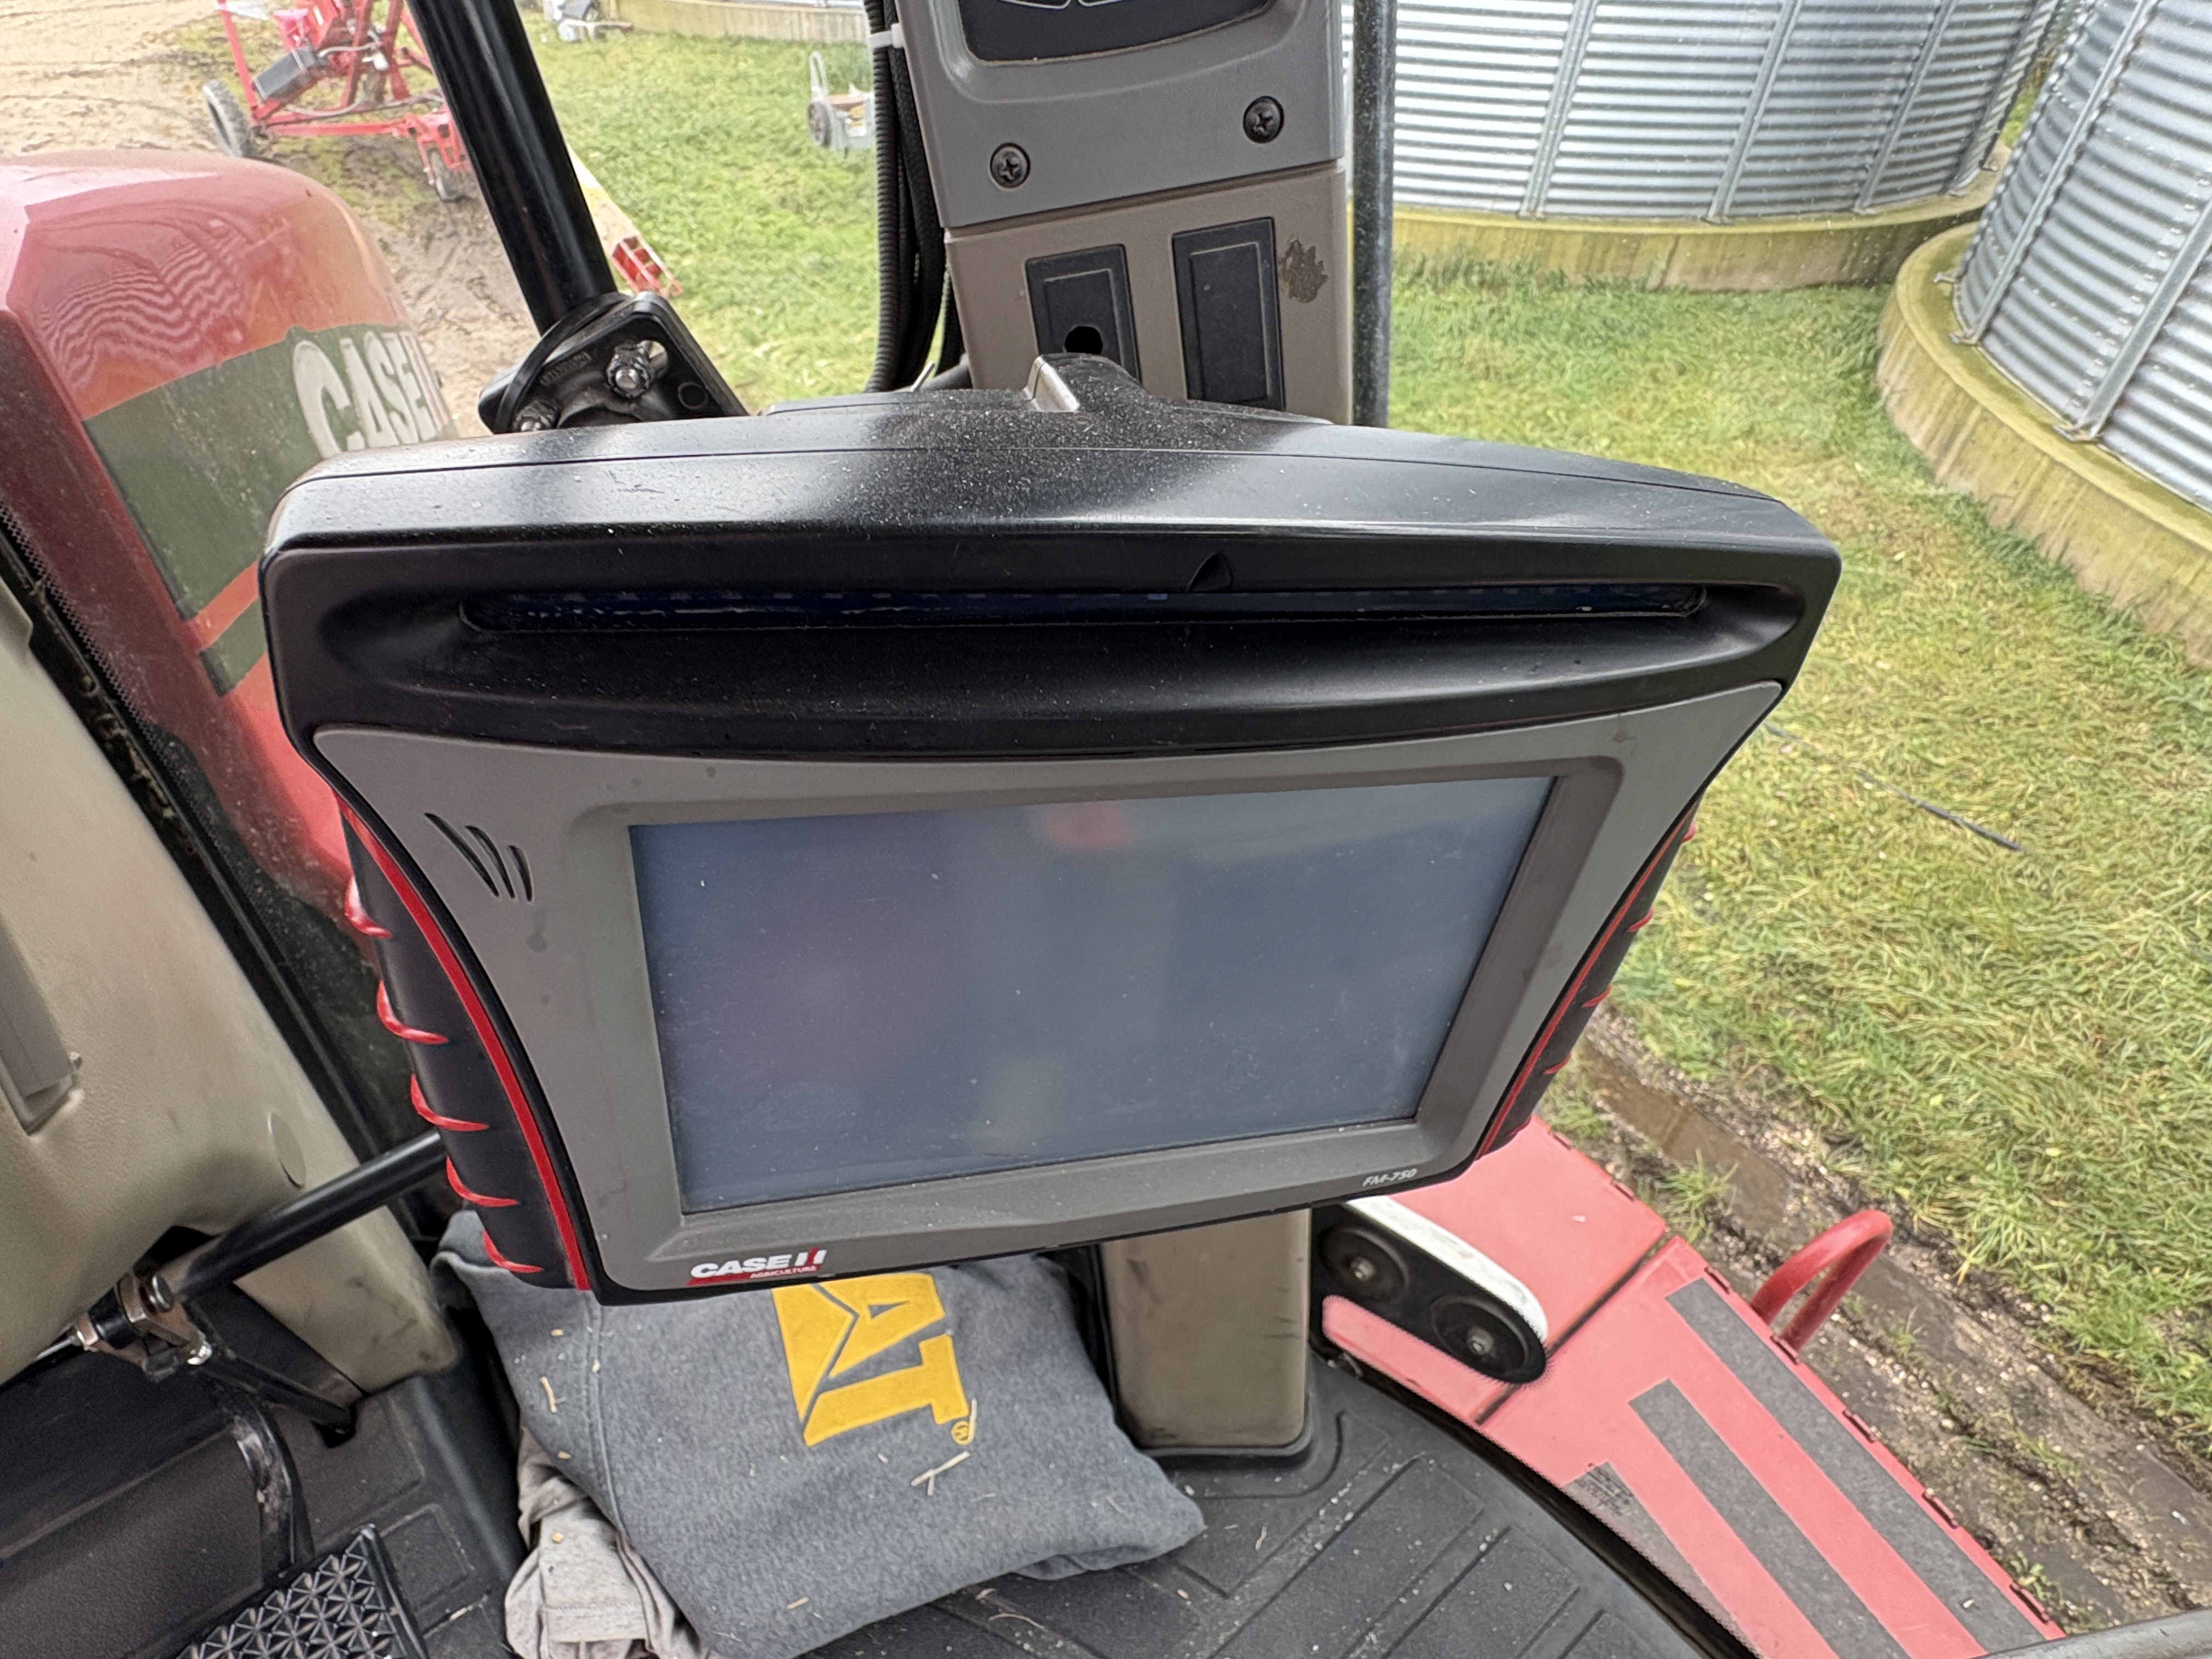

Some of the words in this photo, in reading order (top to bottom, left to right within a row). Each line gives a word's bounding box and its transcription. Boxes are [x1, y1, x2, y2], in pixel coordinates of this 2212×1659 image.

[293, 331, 437, 459] CASE
[1362, 1168, 1417, 1187] FM-750
[690, 1254, 793, 1278] CASE
[749, 1265, 817, 1279] AGRICULTURE
[771, 1273, 969, 1447] AT
